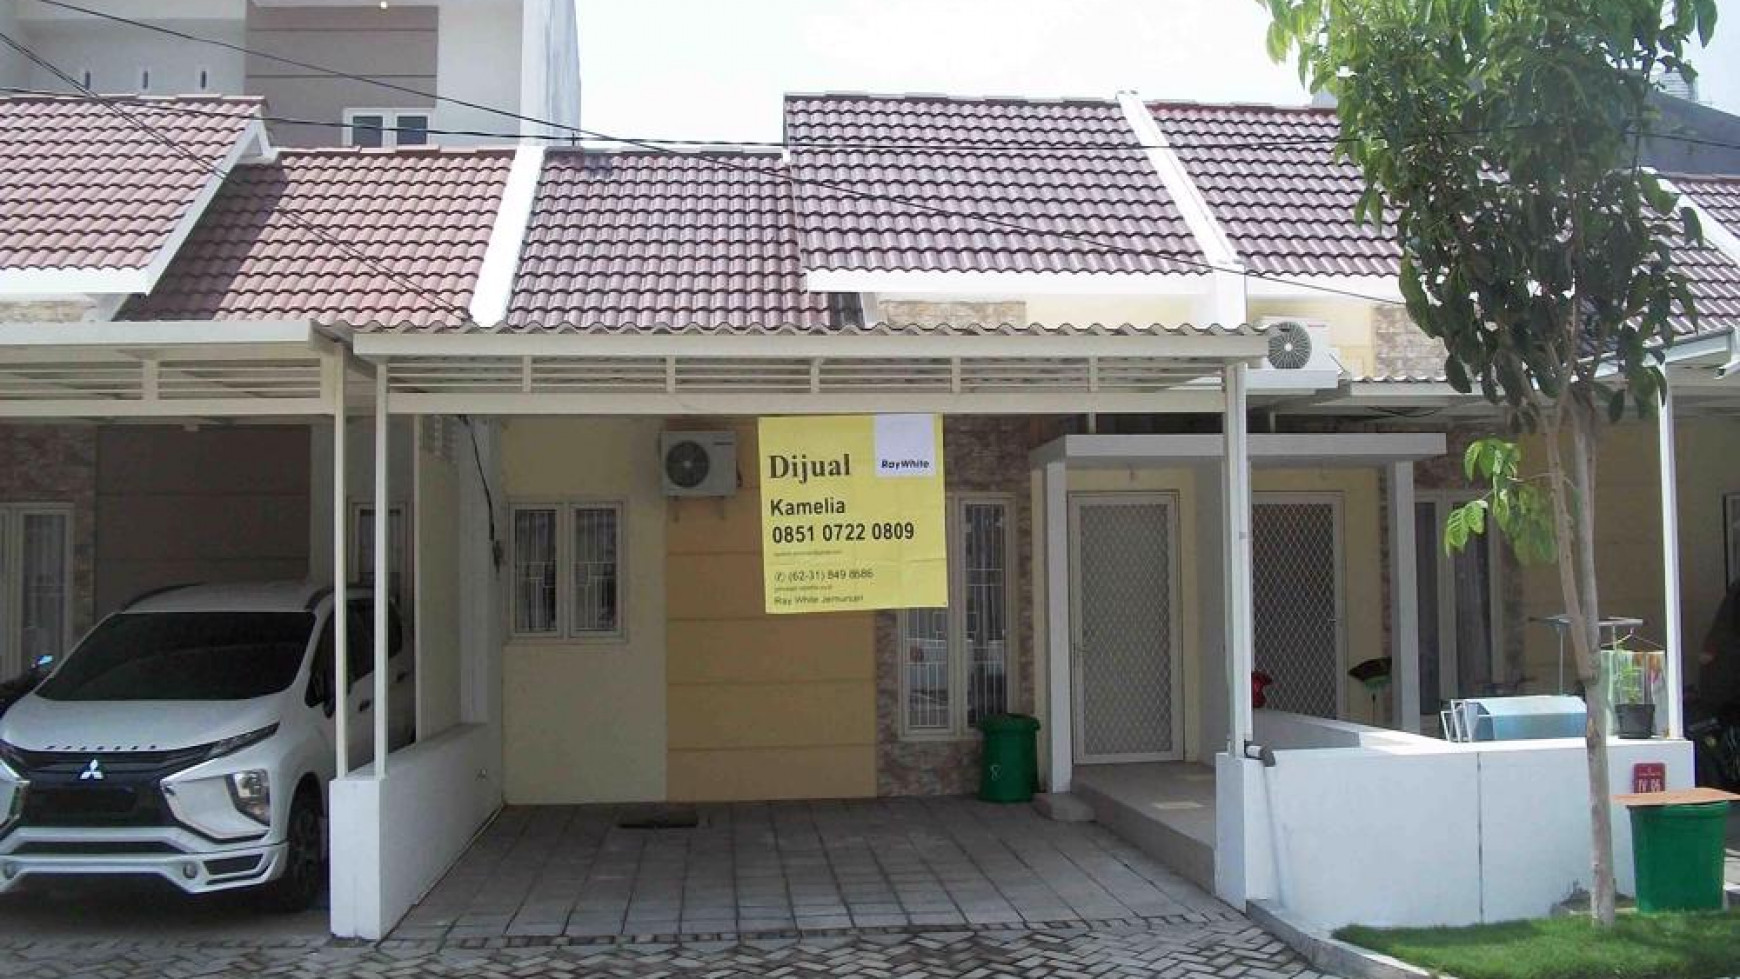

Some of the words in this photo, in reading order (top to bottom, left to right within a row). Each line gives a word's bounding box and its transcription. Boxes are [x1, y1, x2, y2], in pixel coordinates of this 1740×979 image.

[769, 453, 851, 484] Dijual
[770, 497, 846, 516] Kamelia
[772, 526, 815, 543] 0851
[822, 524, 866, 541] 0722
[872, 522, 915, 540] 0809
